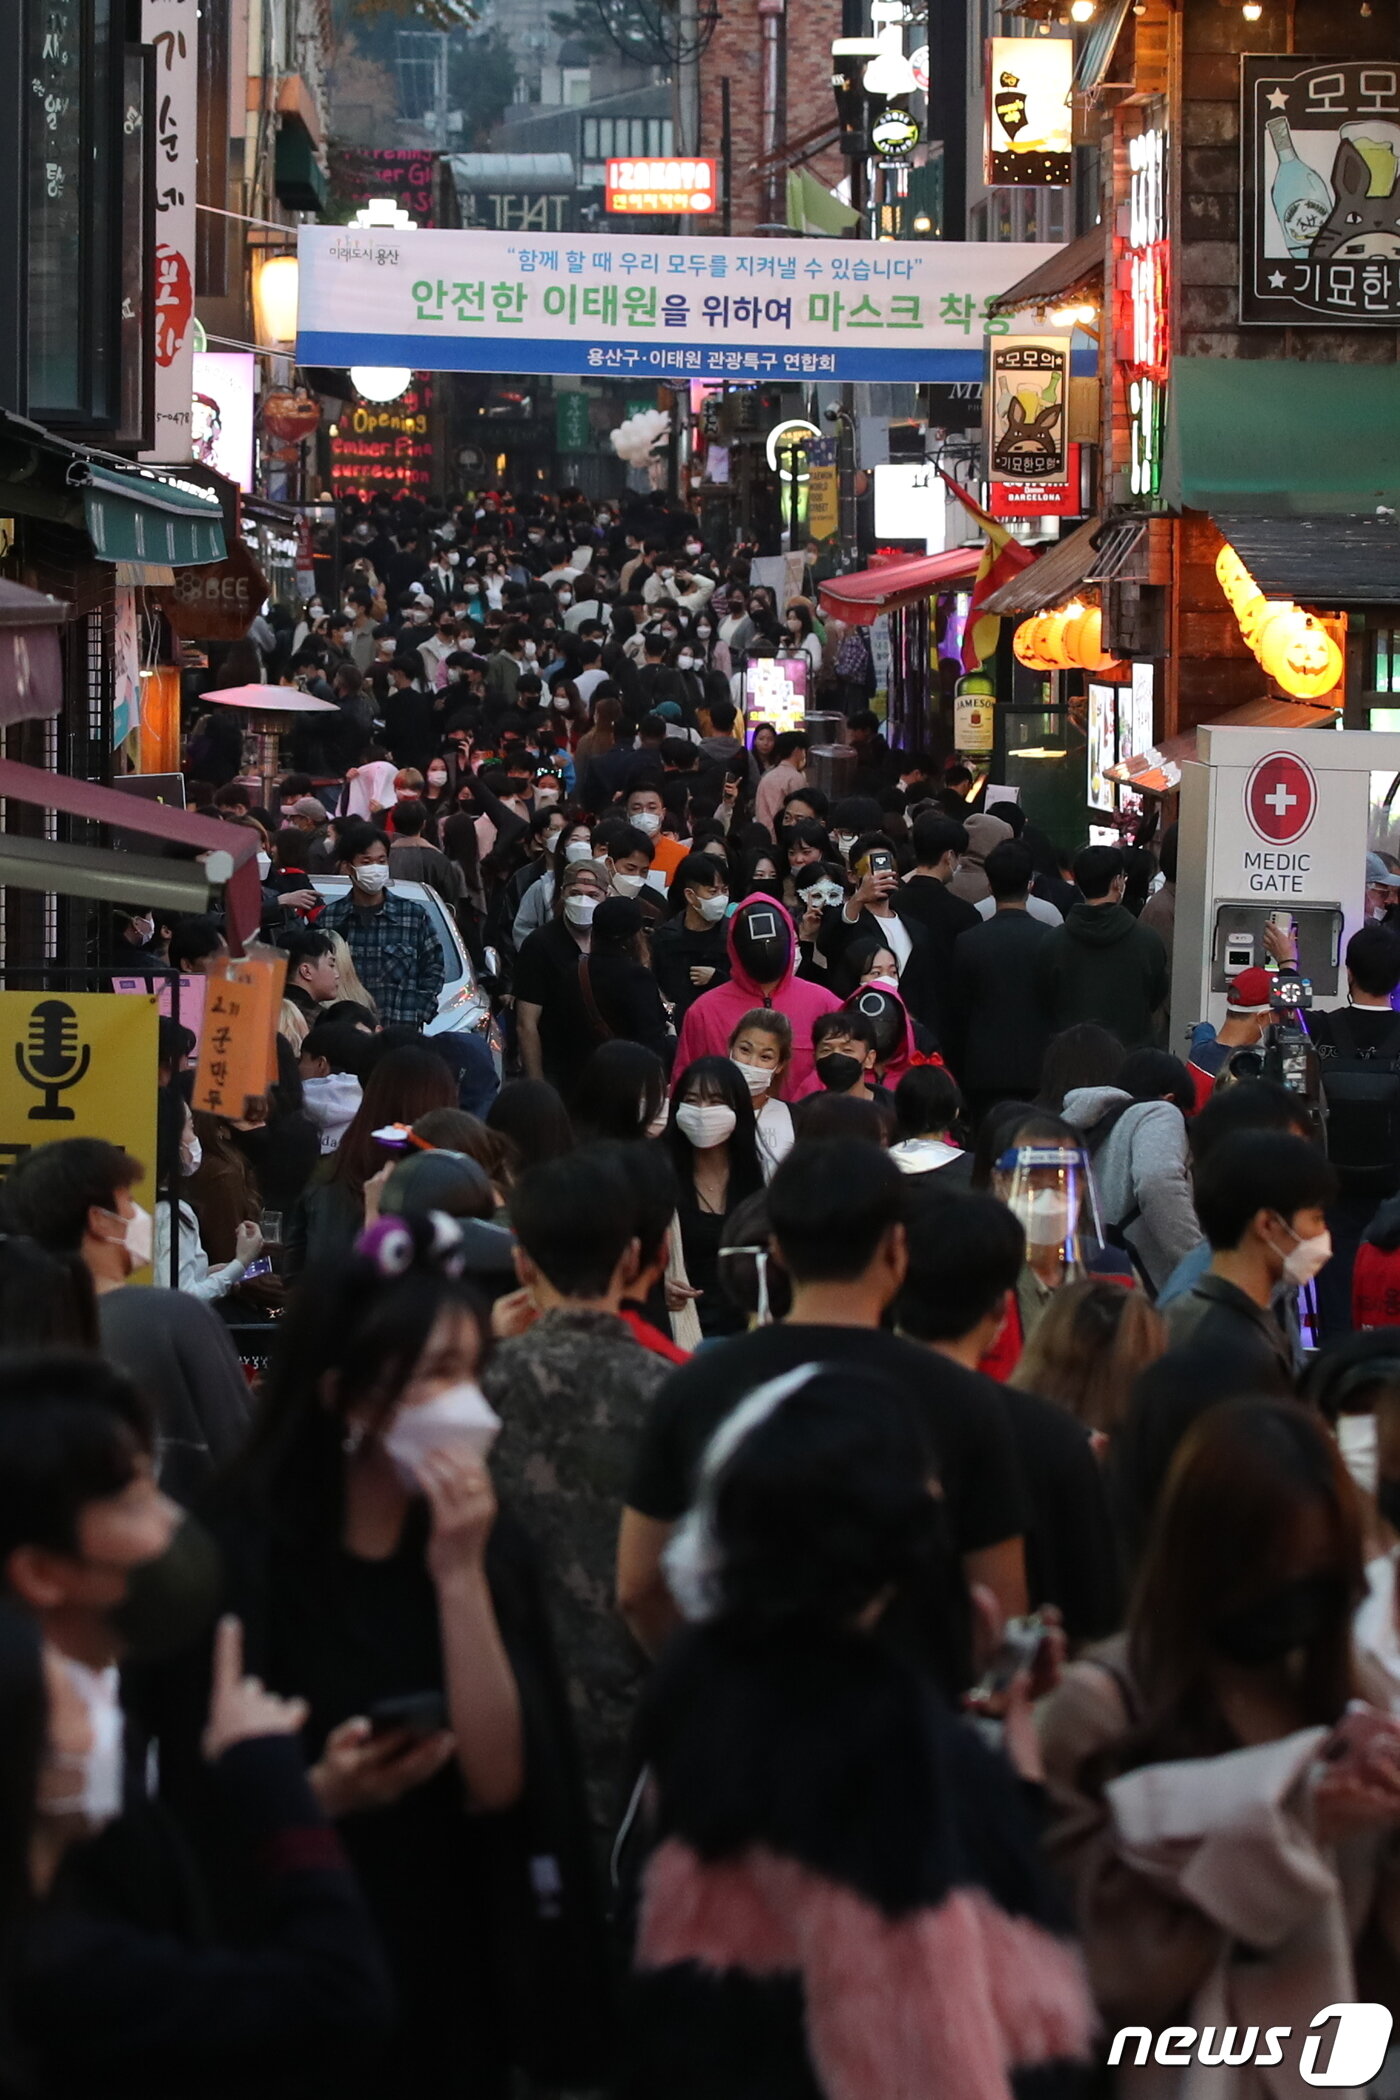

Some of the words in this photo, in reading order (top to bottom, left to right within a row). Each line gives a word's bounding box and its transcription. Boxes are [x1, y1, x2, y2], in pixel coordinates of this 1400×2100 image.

[329, 247, 373, 262] 미래도시
[375, 248, 399, 266] 용산
[566, 250, 586, 274] 할
[592, 252, 612, 273] 때
[619, 252, 659, 275] 우리
[667, 254, 728, 278] 모두를
[735, 255, 797, 280] 지켜낼
[803, 257, 823, 280] 수
[411, 280, 528, 323] 안전한
[543, 284, 690, 328] 이태원을
[701, 295, 793, 330] 위하여
[808, 290, 925, 332] 마스크
[707, 350, 778, 372] 관광특구
[783, 352, 836, 373] 연합회
[1005, 351, 1055, 369] 모모의
[353, 408, 427, 433] Opening
[1008, 493, 1061, 502] BARCELONA
[206, 577, 249, 599] BEE
[1244, 852, 1311, 872] MEDIC
[1249, 874, 1304, 893] GATE
